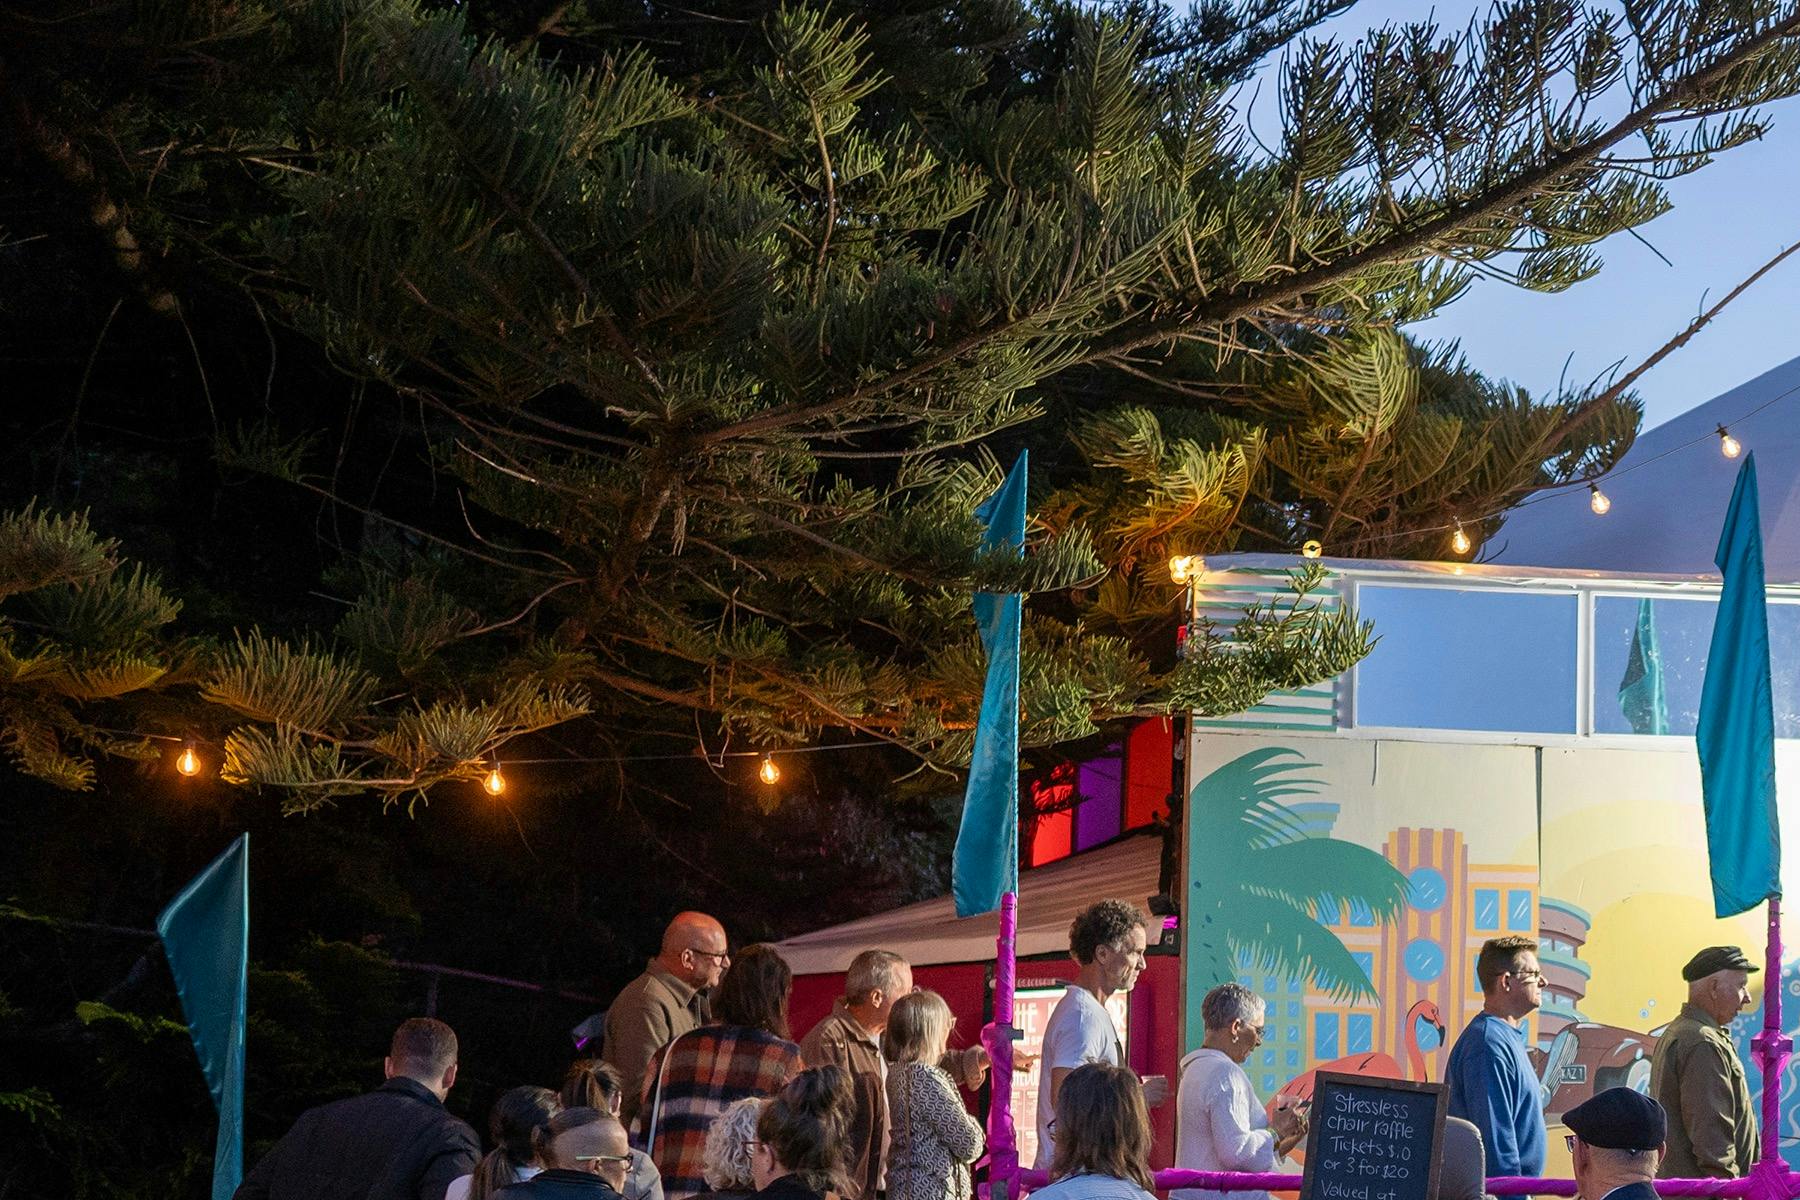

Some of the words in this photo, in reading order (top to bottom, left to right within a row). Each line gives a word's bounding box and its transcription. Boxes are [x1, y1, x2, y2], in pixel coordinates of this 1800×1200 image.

[1335, 1092, 1408, 1119] Stressless
[1327, 1115, 1370, 1133] chair
[1374, 1120, 1414, 1140] raffle
[1330, 1136, 1384, 1156] Tickets
[1323, 1160, 1341, 1170] or
[1346, 1157, 1355, 1173] 3
[1358, 1158, 1380, 1176] for
[1381, 1164, 1409, 1179] $20
[1321, 1179, 1368, 1200] Valued
